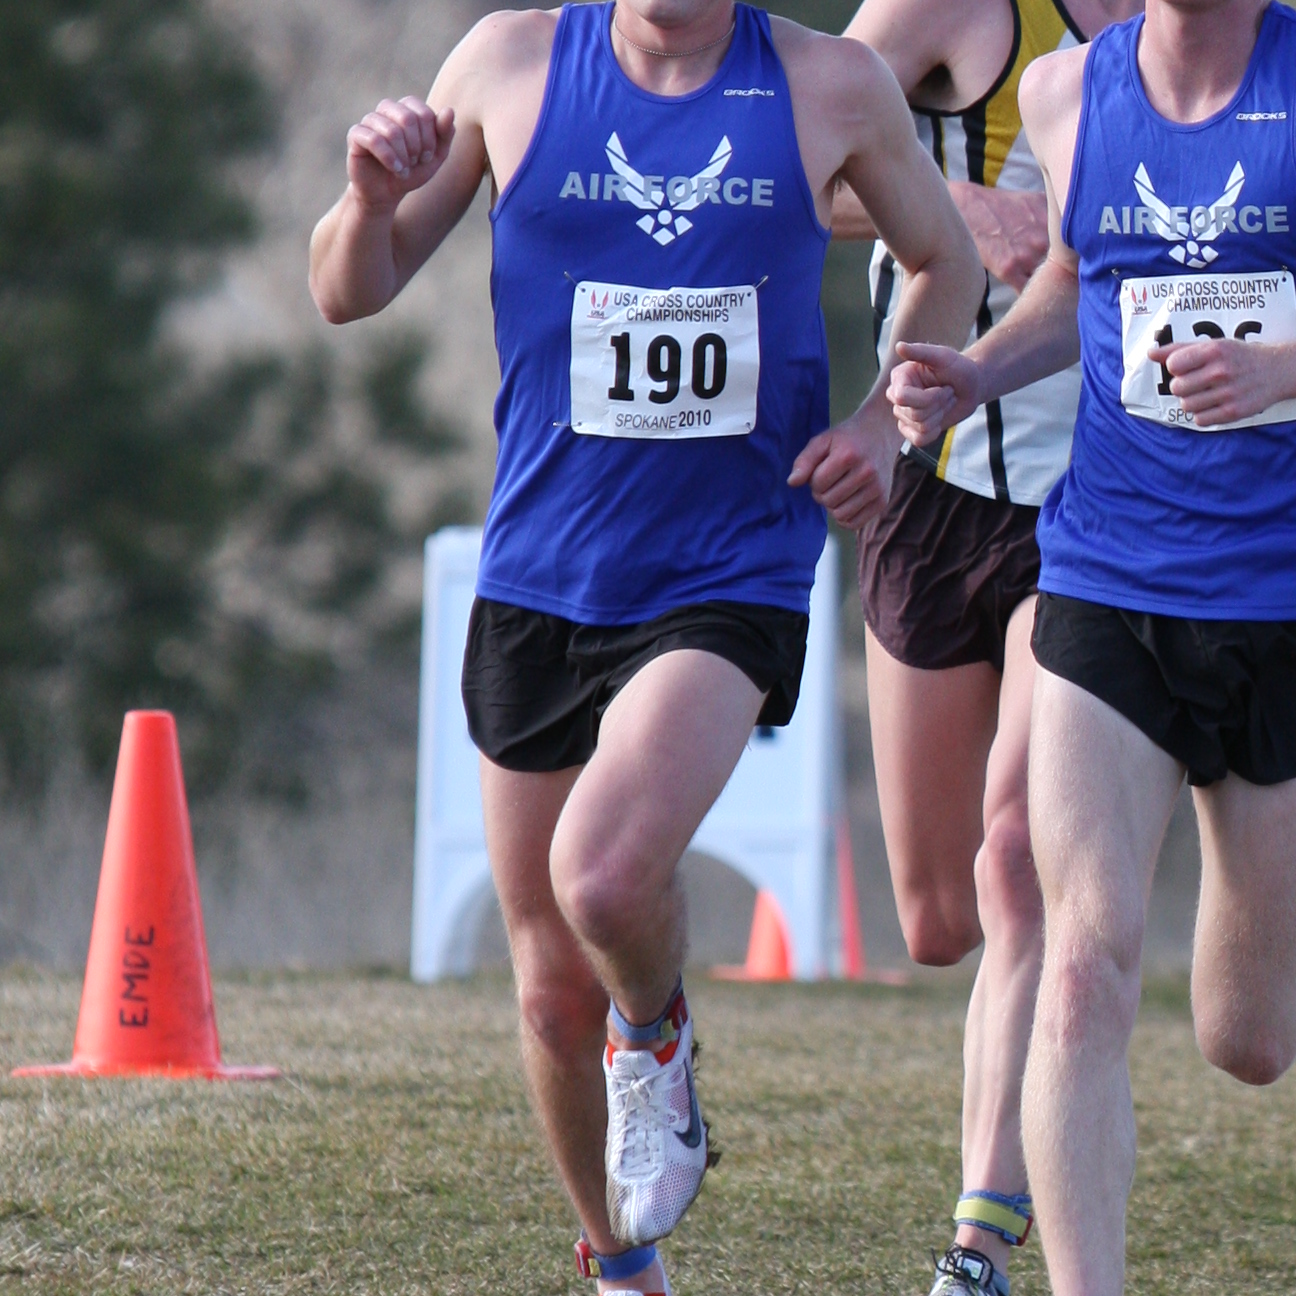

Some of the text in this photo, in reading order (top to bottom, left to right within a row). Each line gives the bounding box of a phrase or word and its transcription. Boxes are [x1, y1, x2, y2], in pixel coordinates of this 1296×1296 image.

[1236, 111, 1287, 121] BROOKS
[558, 171, 775, 207] AIR FORCE
[1098, 206, 1290, 235] AIR FORCE
[1152, 278, 1280, 298] USA CROSS COUNTRY
[614, 292, 745, 308] USA CROSS COUNTRY
[1167, 295, 1266, 312] CHAMPIONSHIPS
[626, 307, 730, 323] CHAMPIONSHIPS
[607, 330, 727, 405] 190
[615, 408, 712, 430] SPOKANE 2010
[119, 925, 155, 1028] EMDE
